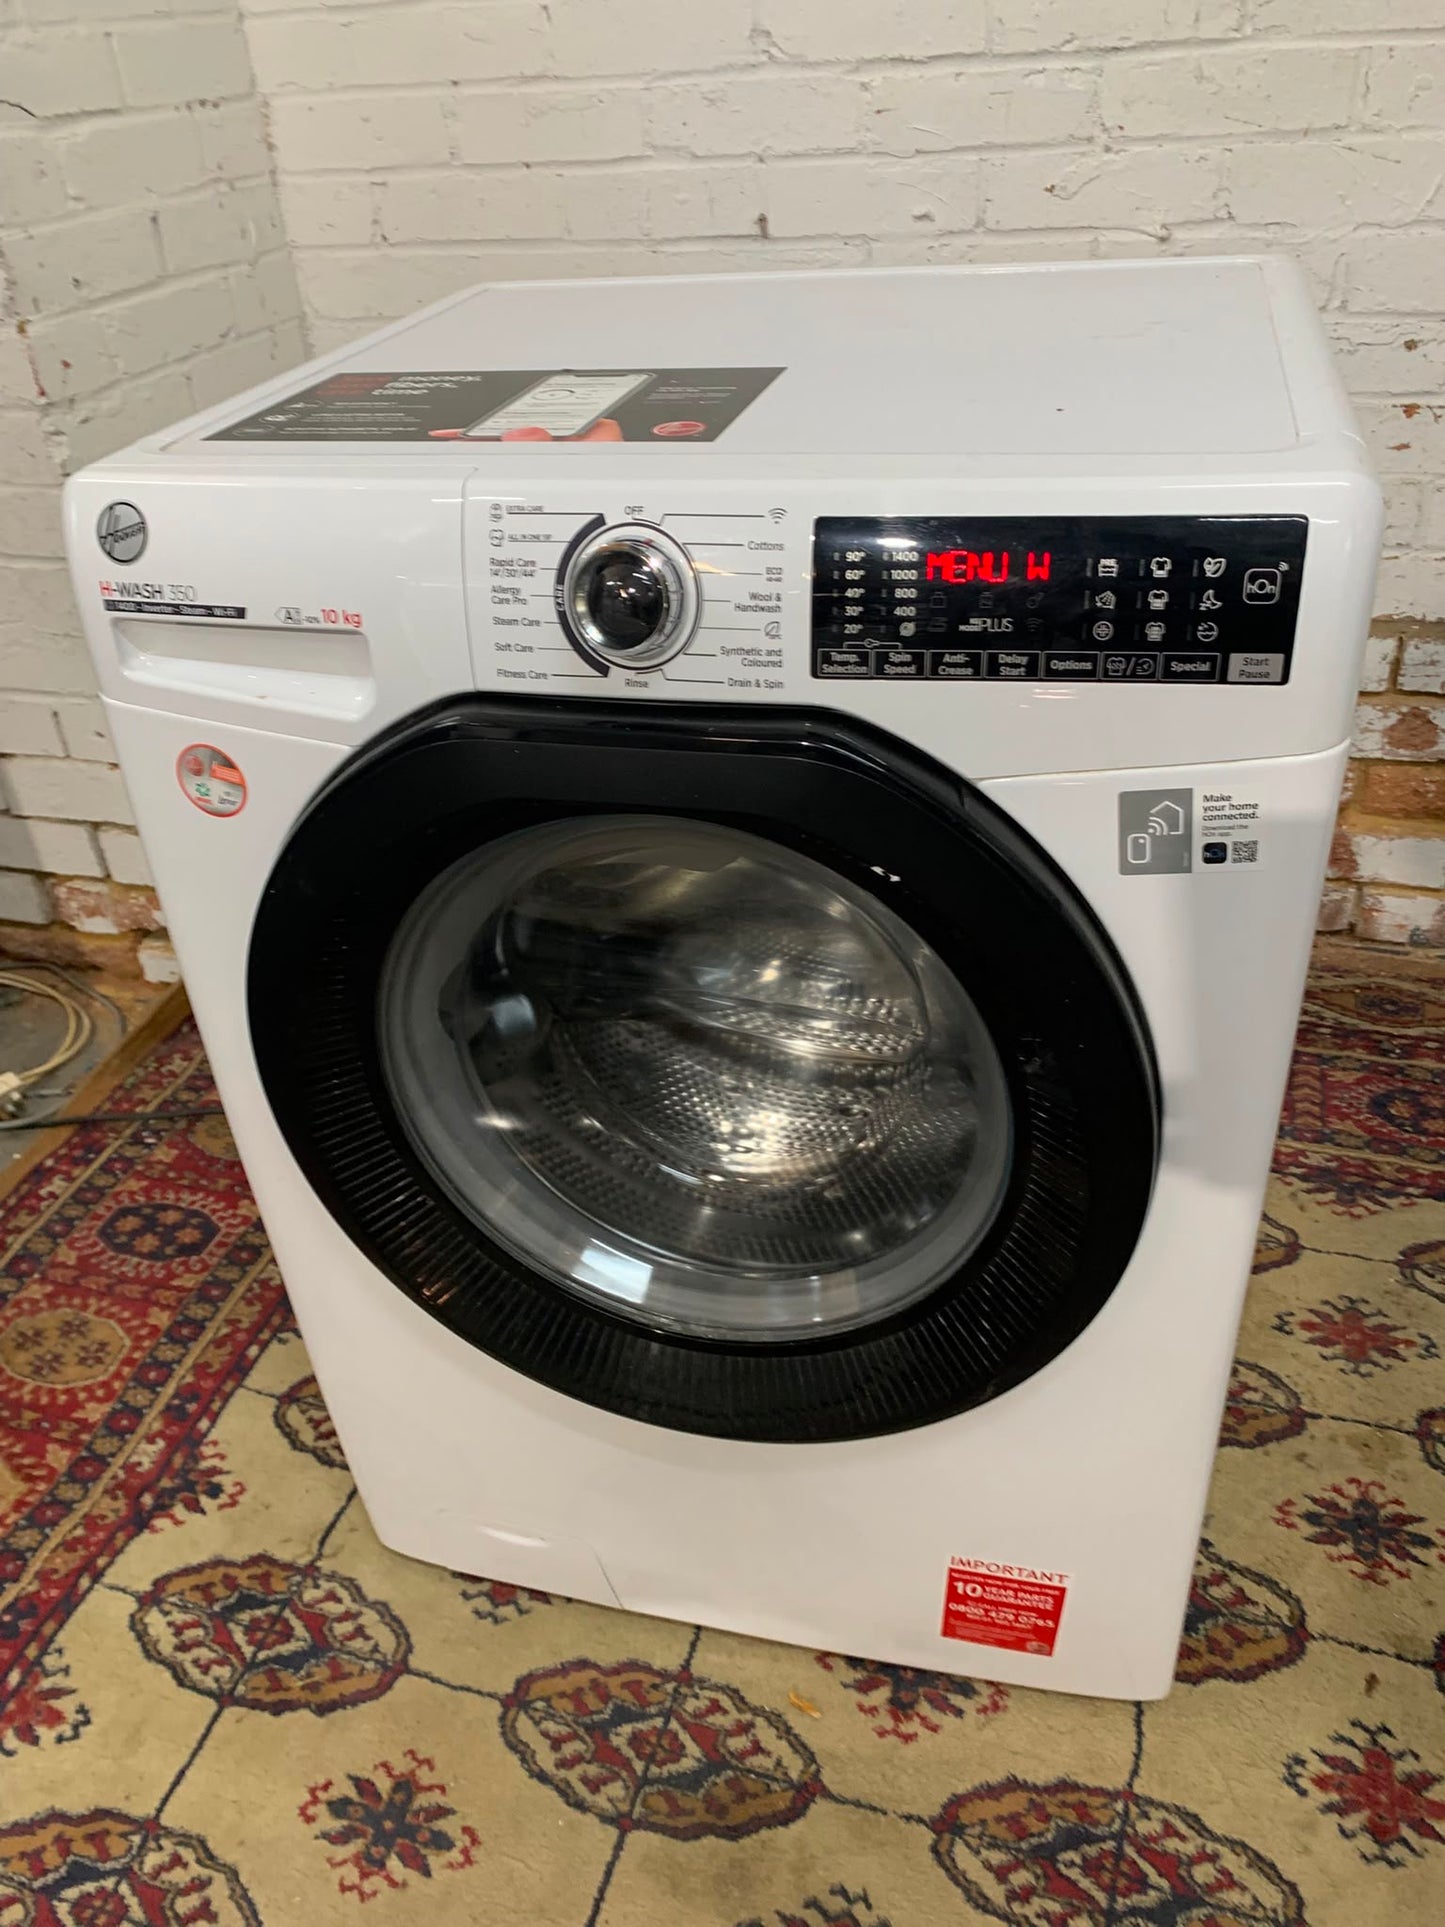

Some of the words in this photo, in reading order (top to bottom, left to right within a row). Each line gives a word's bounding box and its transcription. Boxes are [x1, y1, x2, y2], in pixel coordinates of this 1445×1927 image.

[624, 506, 644, 516] OFF
[747, 540, 785, 551] Cottons
[845, 551, 867, 562] 90°
[892, 551, 920, 562] 1400
[490, 557, 514, 568] Rapid
[516, 558, 536, 568] Care
[925, 549, 1010, 584] MENU
[1026, 551, 1052, 582] W
[766, 566, 782, 576] ECO
[844, 569, 866, 580] 60°
[890, 570, 919, 580] 1000
[98, 580, 165, 600] H-WASH
[167, 584, 198, 602] 350
[490, 585, 521, 596] Allergy
[1246, 579, 1276, 594] hOn
[748, 592, 772, 602] Wool
[774, 592, 782, 602] &
[844, 588, 866, 598] 40°
[894, 588, 918, 598] 800
[490, 596, 511, 605] Care
[512, 596, 527, 606] Pro
[734, 602, 782, 613] Handwash
[844, 606, 864, 616] 30°
[893, 606, 917, 616] 400
[320, 608, 338, 624] 10
[342, 608, 362, 628] kg
[492, 616, 519, 626] Steam
[520, 617, 542, 627] Care
[844, 624, 864, 634] 20°
[980, 617, 1014, 632] PLUS
[494, 642, 513, 652] Soft
[514, 643, 535, 653] Care
[720, 645, 763, 657] Synthetic
[764, 648, 783, 657] and
[741, 657, 783, 668] Coloured
[830, 652, 861, 663] Temp.
[888, 652, 912, 664] Spin
[942, 653, 970, 664] Anti-
[998, 654, 1029, 666] Delay
[1243, 656, 1270, 667] Start
[822, 664, 868, 674] Selection
[884, 664, 916, 675] Speed
[938, 665, 974, 676] Crease
[1000, 666, 1026, 676] Start
[1050, 659, 1094, 672] Options
[1170, 660, 1211, 672] Special
[496, 668, 526, 678] Fitness
[528, 670, 549, 680] Care
[1238, 669, 1271, 680] Pause
[624, 678, 649, 689] Rinse
[728, 677, 752, 688] Drain
[754, 678, 761, 689] &
[763, 679, 785, 690] Spin
[1202, 794, 1232, 802] Make
[1202, 804, 1227, 814] your
[1228, 803, 1259, 811] home
[1202, 811, 1261, 822] connected.
[950, 1555, 1070, 1584] IMPORTANT
[953, 1581, 983, 1598] 10
